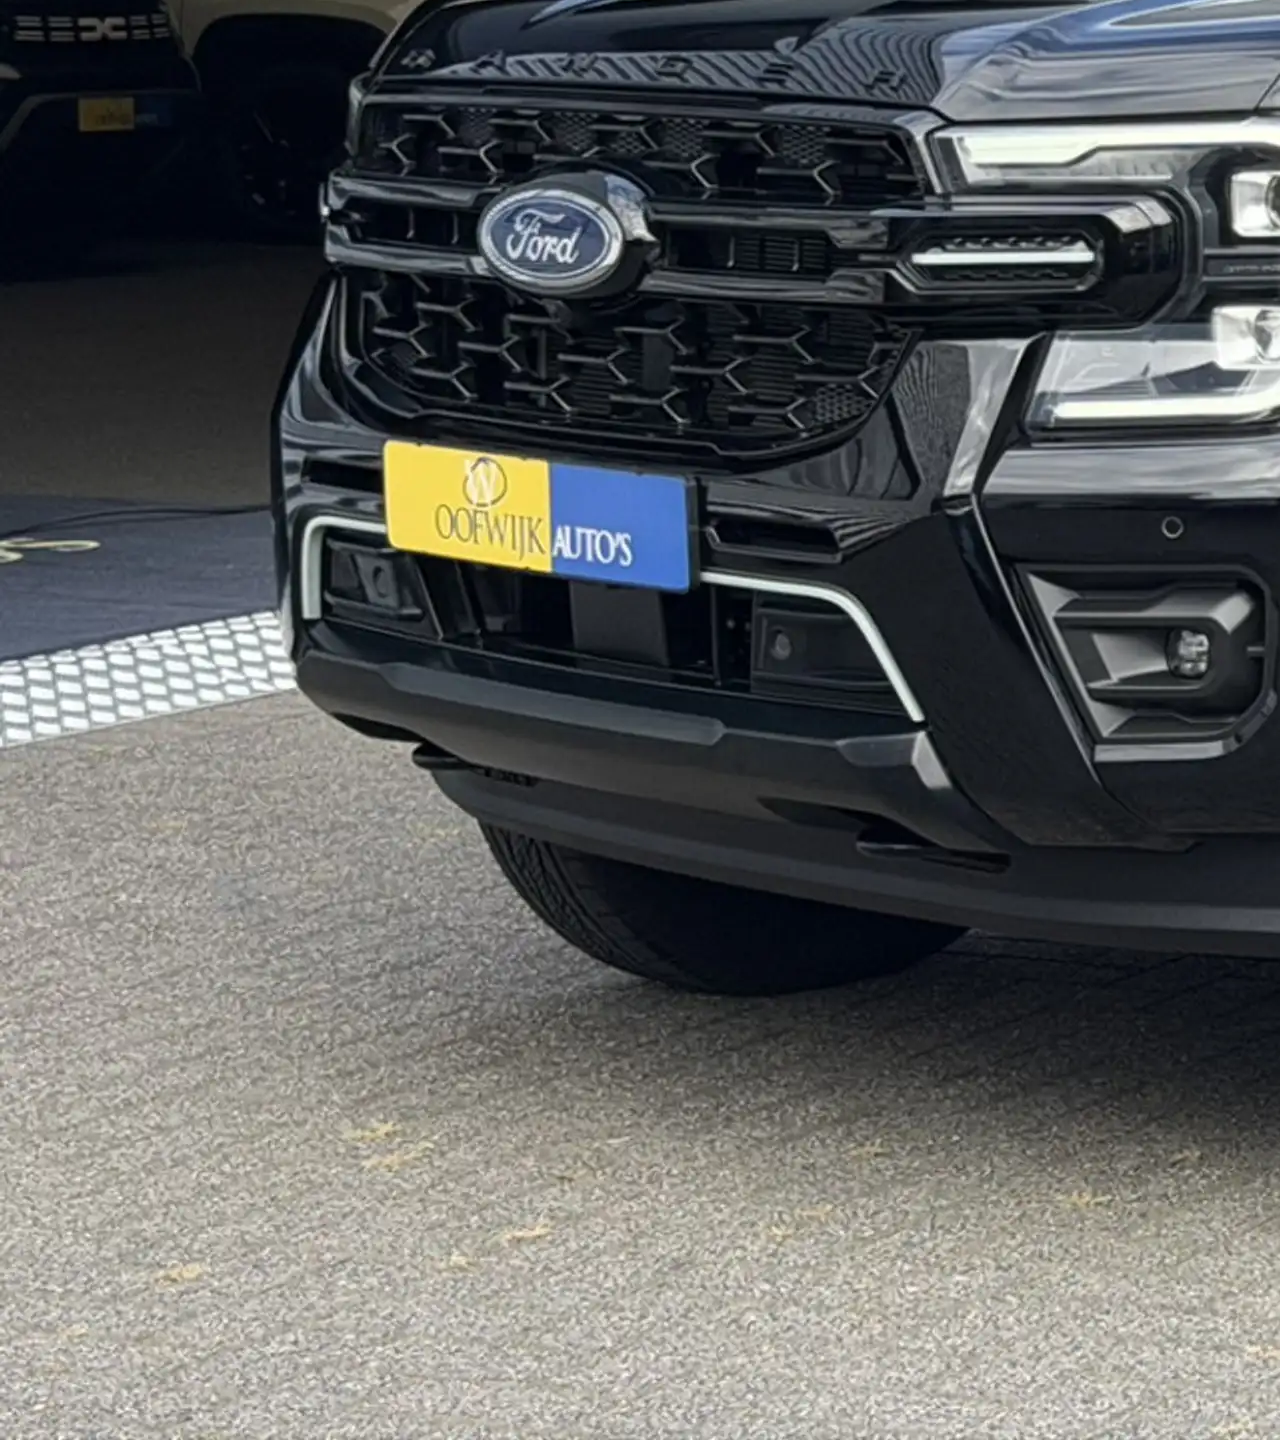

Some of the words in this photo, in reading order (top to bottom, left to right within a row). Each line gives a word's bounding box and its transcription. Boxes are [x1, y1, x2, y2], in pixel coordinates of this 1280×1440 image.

[506, 208, 582, 263] Ford
[434, 502, 546, 561] OOFWIJK
[551, 524, 633, 567] AUTO'S
